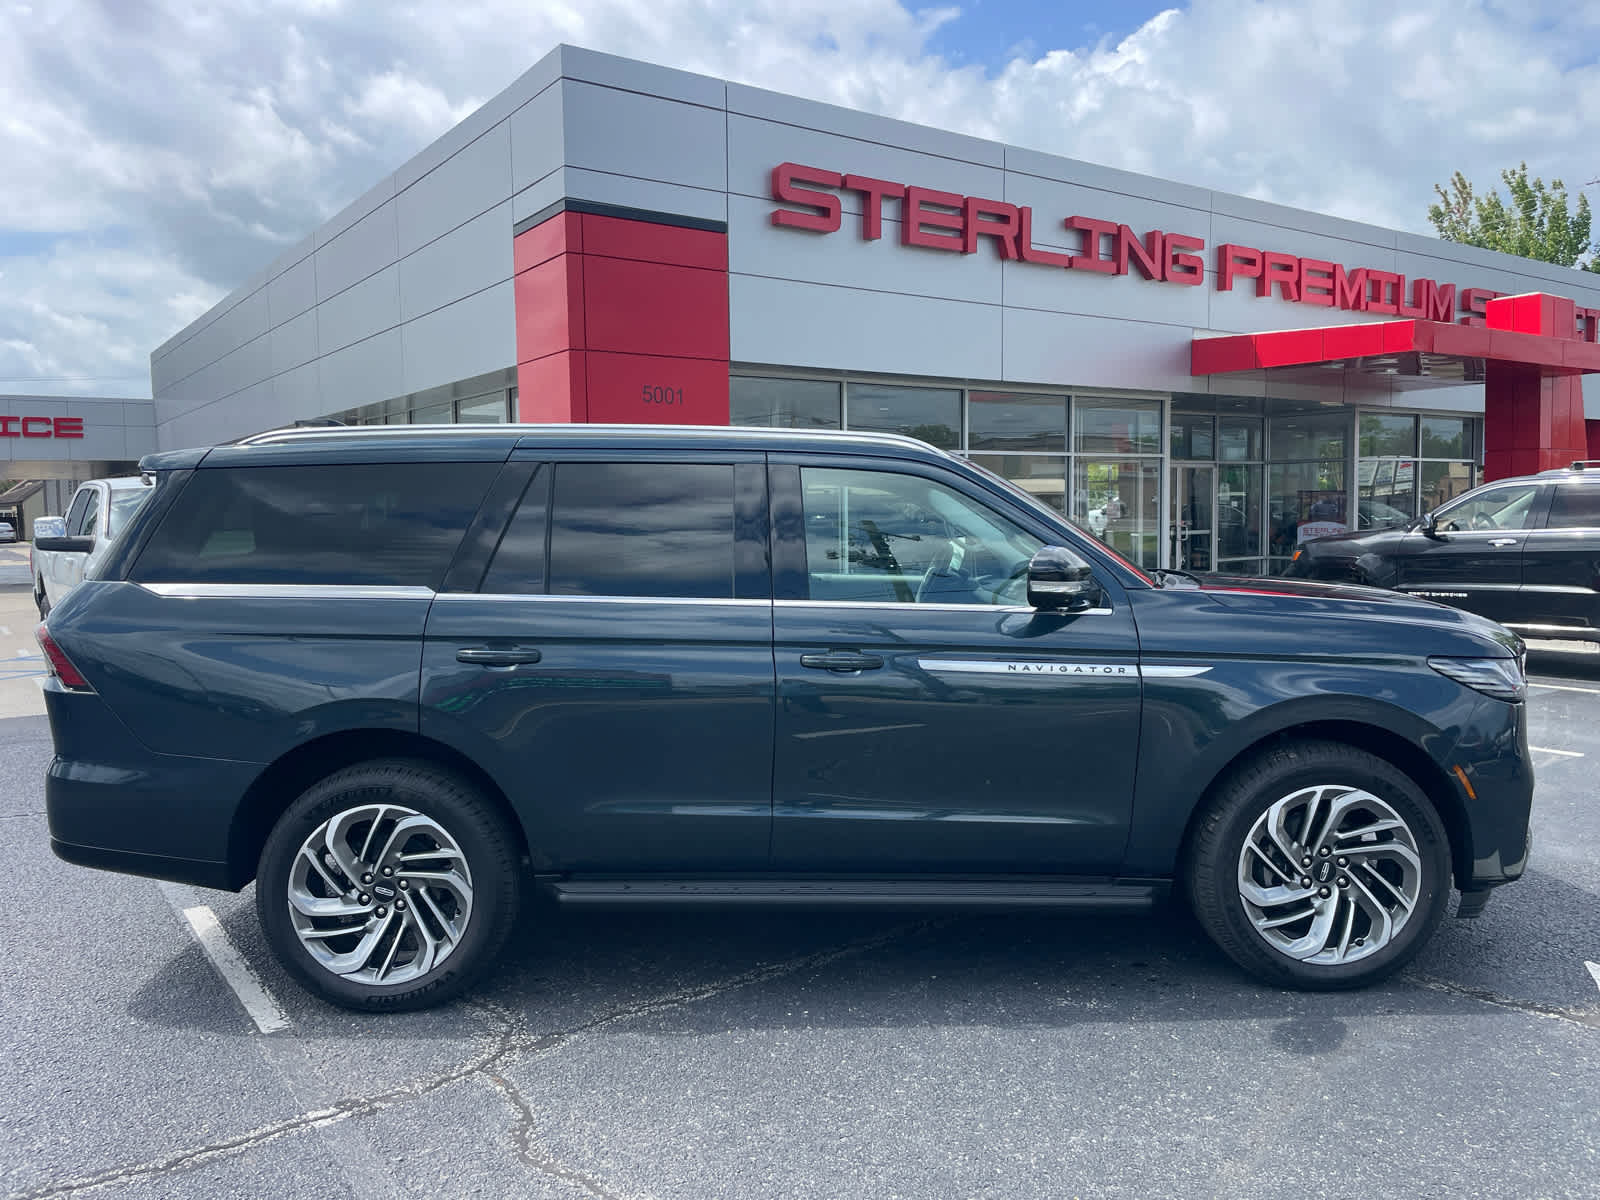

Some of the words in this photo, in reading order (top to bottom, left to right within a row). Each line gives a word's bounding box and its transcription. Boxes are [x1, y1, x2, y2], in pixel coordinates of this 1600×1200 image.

[771, 162, 1205, 287] STERLING
[1216, 243, 1456, 324] PREMIUM
[641, 384, 683, 406] 5001
[0, 415, 84, 438] ICE
[1007, 664, 1126, 674] NAVIGATOR
